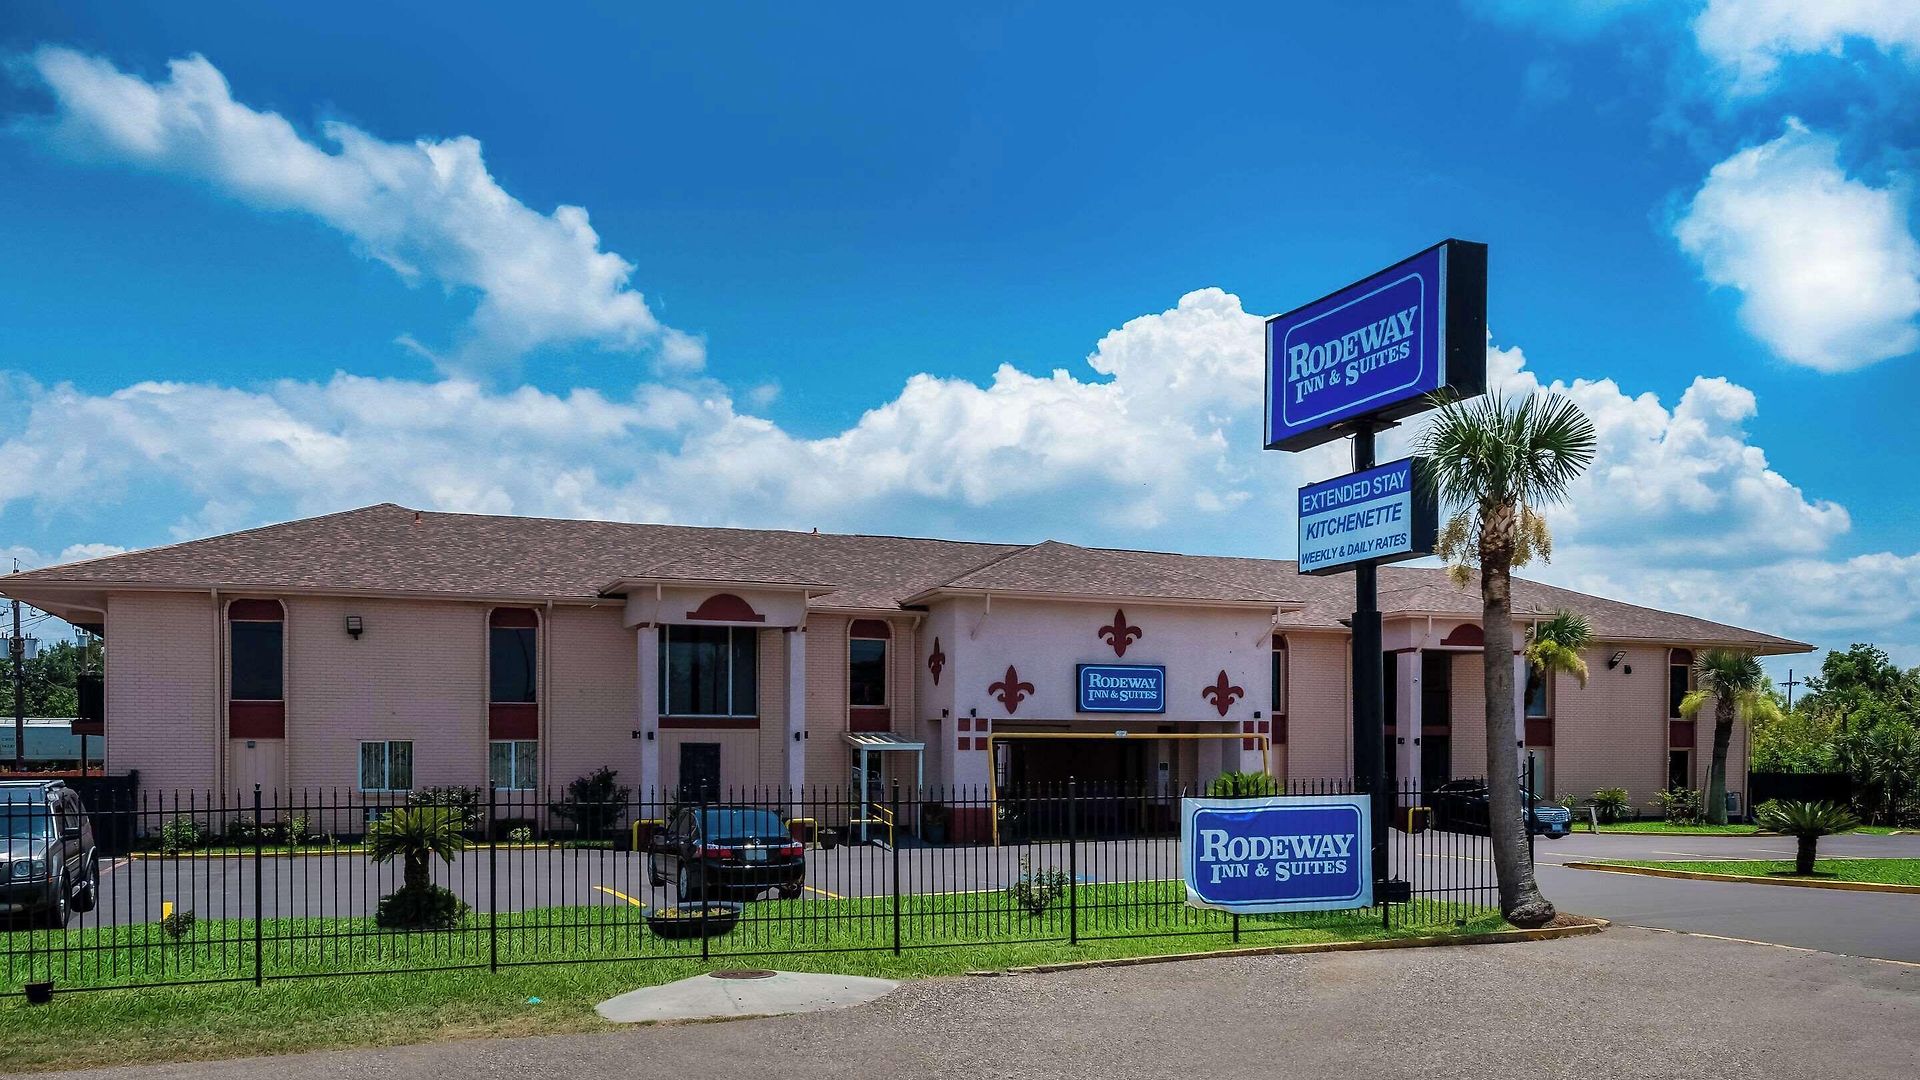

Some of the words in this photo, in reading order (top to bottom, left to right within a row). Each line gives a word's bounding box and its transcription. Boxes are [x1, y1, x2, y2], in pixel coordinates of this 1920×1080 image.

[1288, 305, 1418, 383] RODEWAY
[1295, 373, 1325, 404] INN
[1329, 370, 1341, 385] &
[1345, 340, 1410, 386] SUITES
[1302, 480, 1371, 513] EXTENDED
[1373, 469, 1407, 495] STAY
[1306, 502, 1402, 541] KITCHENETTE
[1301, 546, 1338, 565] WEEKLY
[1339, 545, 1345, 557] &
[1347, 539, 1374, 556] DAILY
[1375, 532, 1407, 550] RATES
[1088, 673, 1157, 689] RODEWAY
[1088, 689, 1110, 701] INN
[1110, 690, 1119, 699] &
[1119, 690, 1157, 702] SUITES
[1199, 829, 1355, 862] RODEWAY
[1210, 863, 1250, 884] INN
[1254, 863, 1270, 877] &
[1275, 859, 1348, 882] SUITES
